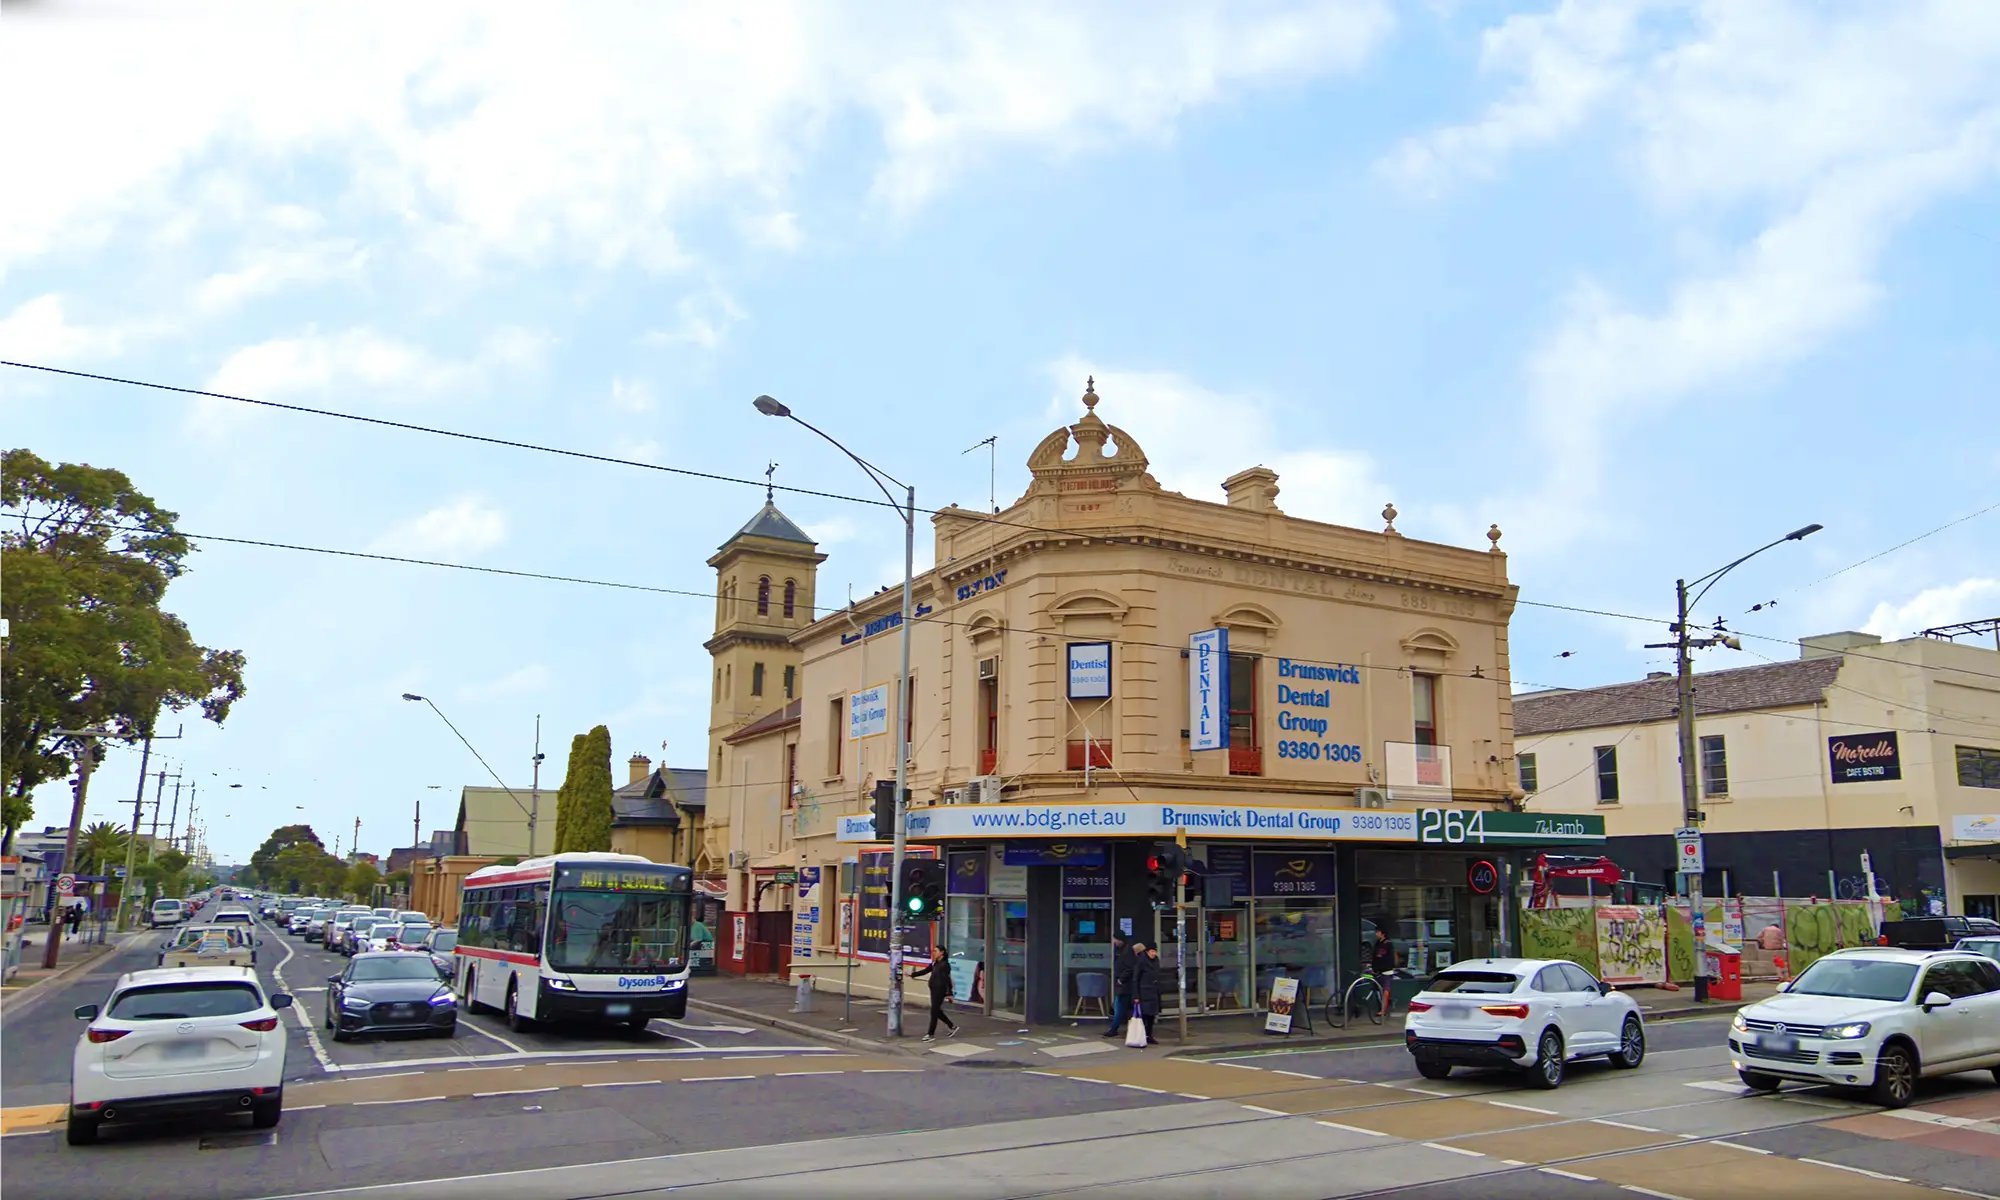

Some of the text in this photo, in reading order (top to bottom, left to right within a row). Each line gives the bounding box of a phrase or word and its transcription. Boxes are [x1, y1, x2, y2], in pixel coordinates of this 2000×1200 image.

[864, 611, 903, 637] DENTA
[1071, 659, 1107, 670] Dentist
[1278, 657, 1360, 684] Brunswick
[1199, 643, 1211, 736] DENTAL
[1278, 684, 1330, 708] Dental
[1278, 711, 1328, 737] Group
[1278, 740, 1361, 762] 9380 1305
[1832, 741, 1895, 764] Marcella
[972, 809, 1127, 831] www.bdg.net.au
[1162, 807, 1412, 834] Brunswick Dental Group 9380 1305
[1422, 808, 1485, 843] 264
[1550, 819, 1585, 835] Lamb
[621, 873, 667, 890] SERVICE
[1090, 877, 1109, 886] 1305
[1273, 882, 1316, 892] 9380 1305
[1475, 870, 1493, 884] 40
[618, 976, 655, 989] Dysons
